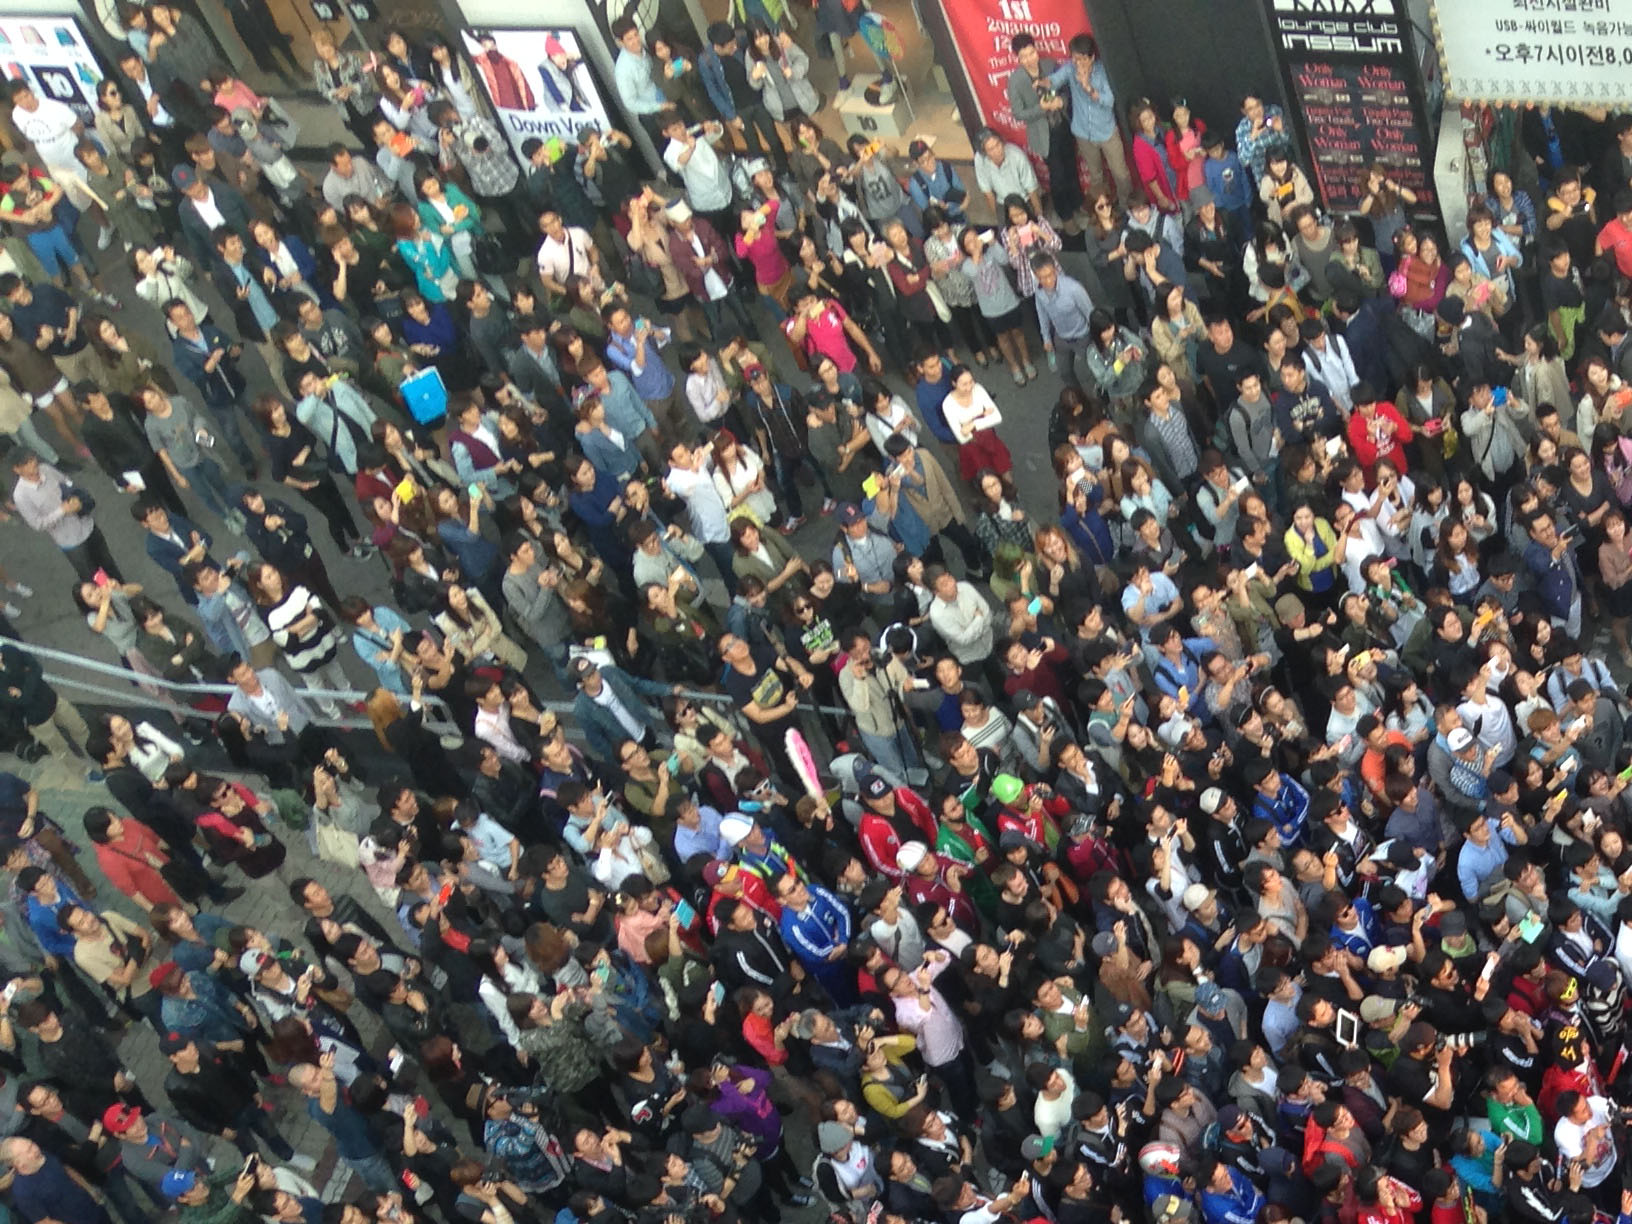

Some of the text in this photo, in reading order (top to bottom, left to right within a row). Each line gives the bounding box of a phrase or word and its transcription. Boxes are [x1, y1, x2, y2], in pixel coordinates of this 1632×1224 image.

[1277, 17, 1398, 35] lounge club
[509, 113, 561, 135] Down
